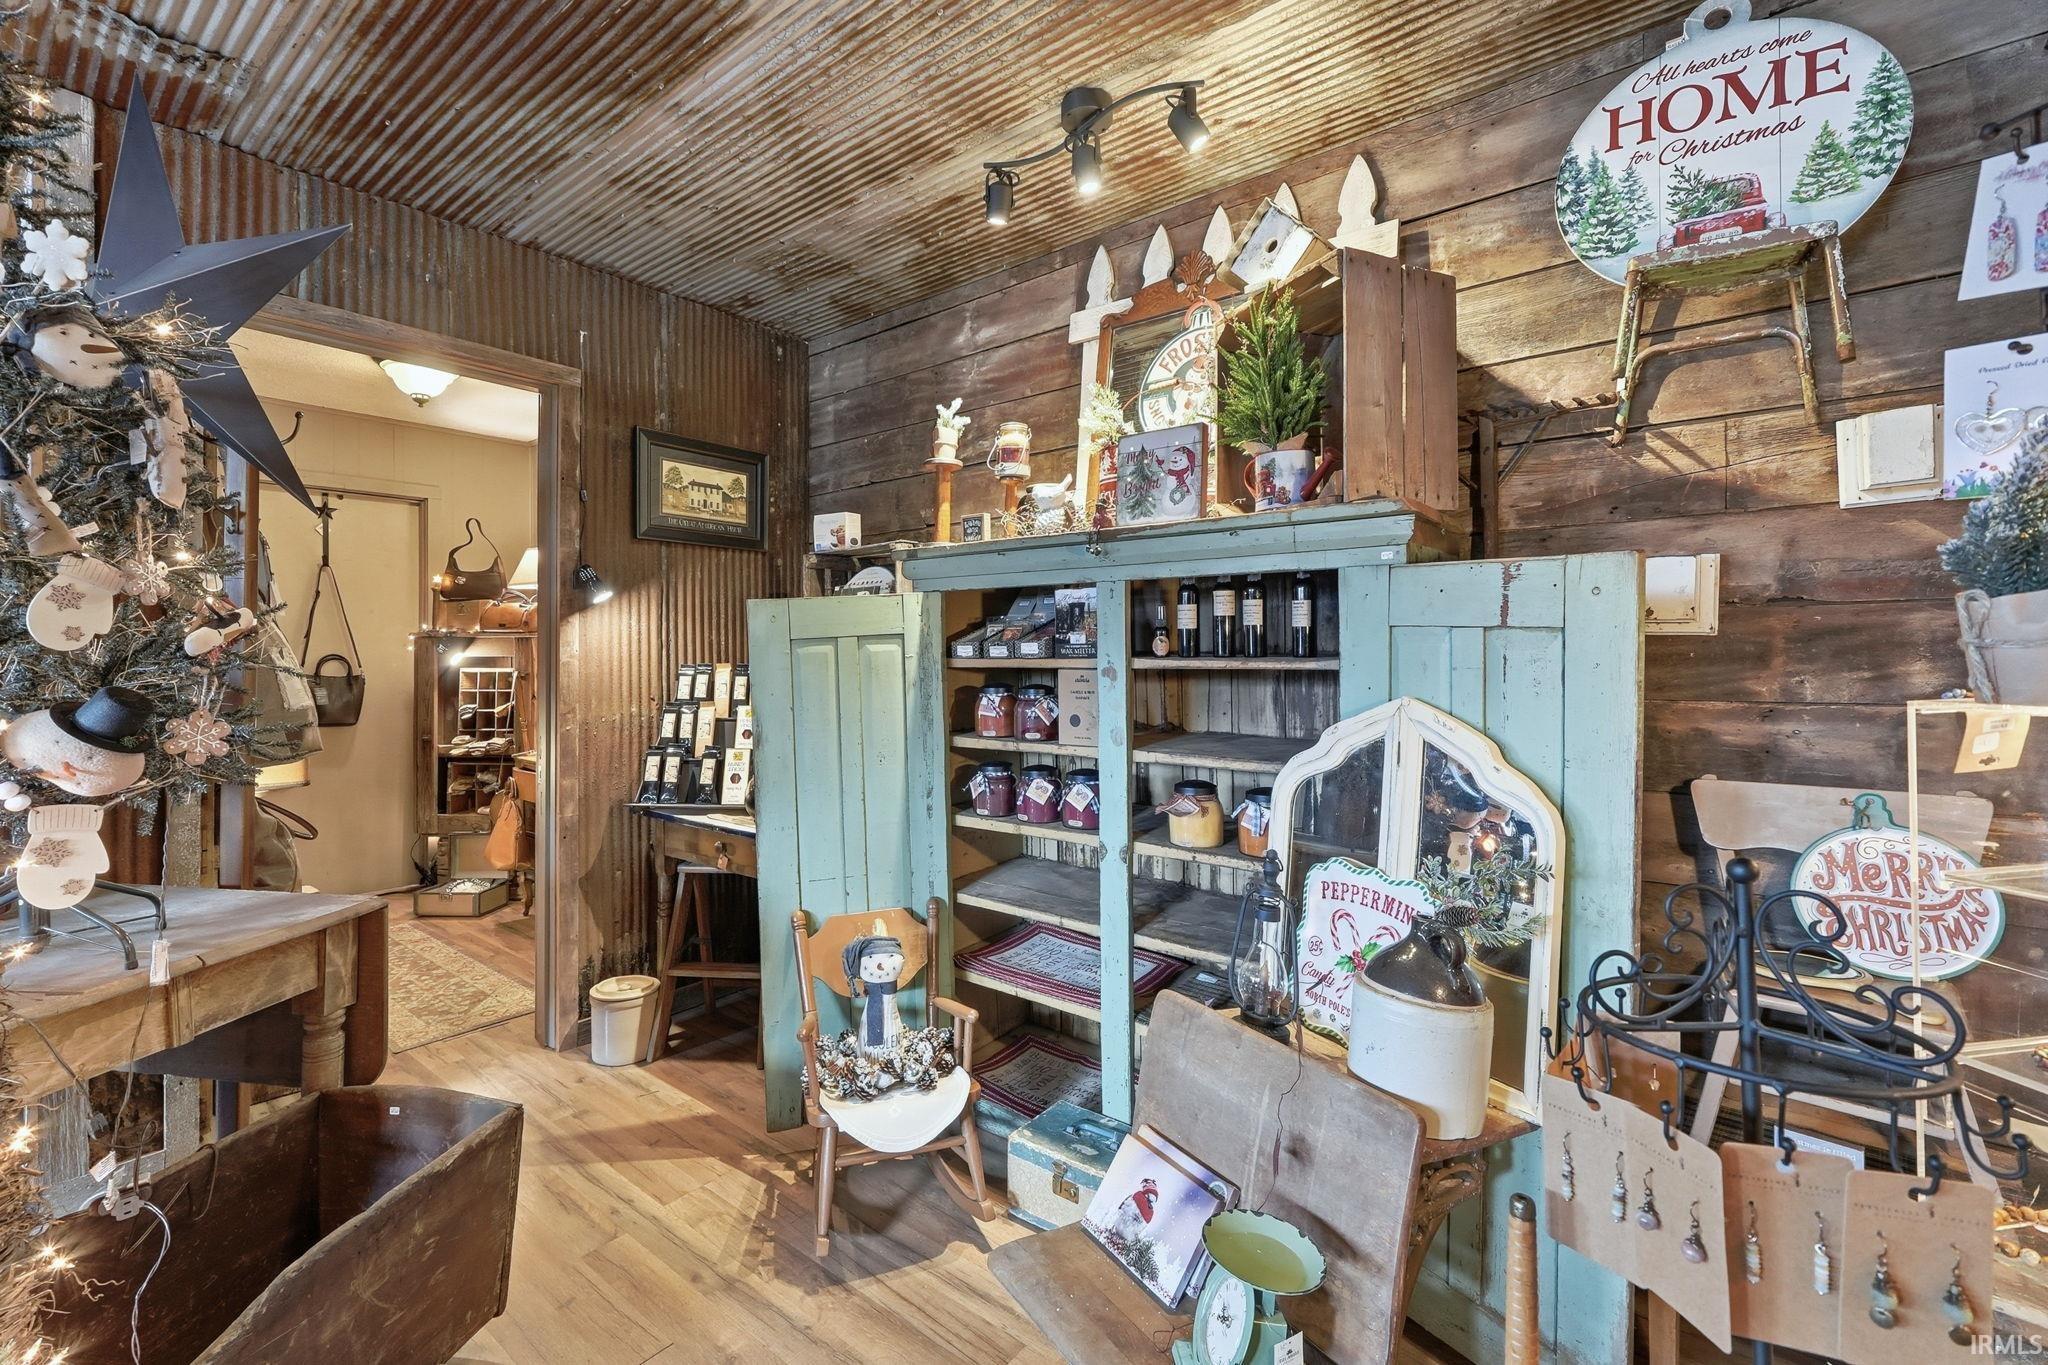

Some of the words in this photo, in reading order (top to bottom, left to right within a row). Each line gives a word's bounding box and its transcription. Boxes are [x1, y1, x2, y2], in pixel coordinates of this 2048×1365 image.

[1631, 64, 1680, 95] All
[1682, 43, 1755, 78] hearts
[1758, 29, 1814, 55] come
[1601, 38, 1851, 153] HOME
[1624, 151, 1656, 172] for
[1658, 115, 1806, 167] Christmas
[1158, 331, 1209, 374] FROS
[1124, 448, 1156, 465] Mey
[1320, 880, 1423, 926] PEPPERMIN
